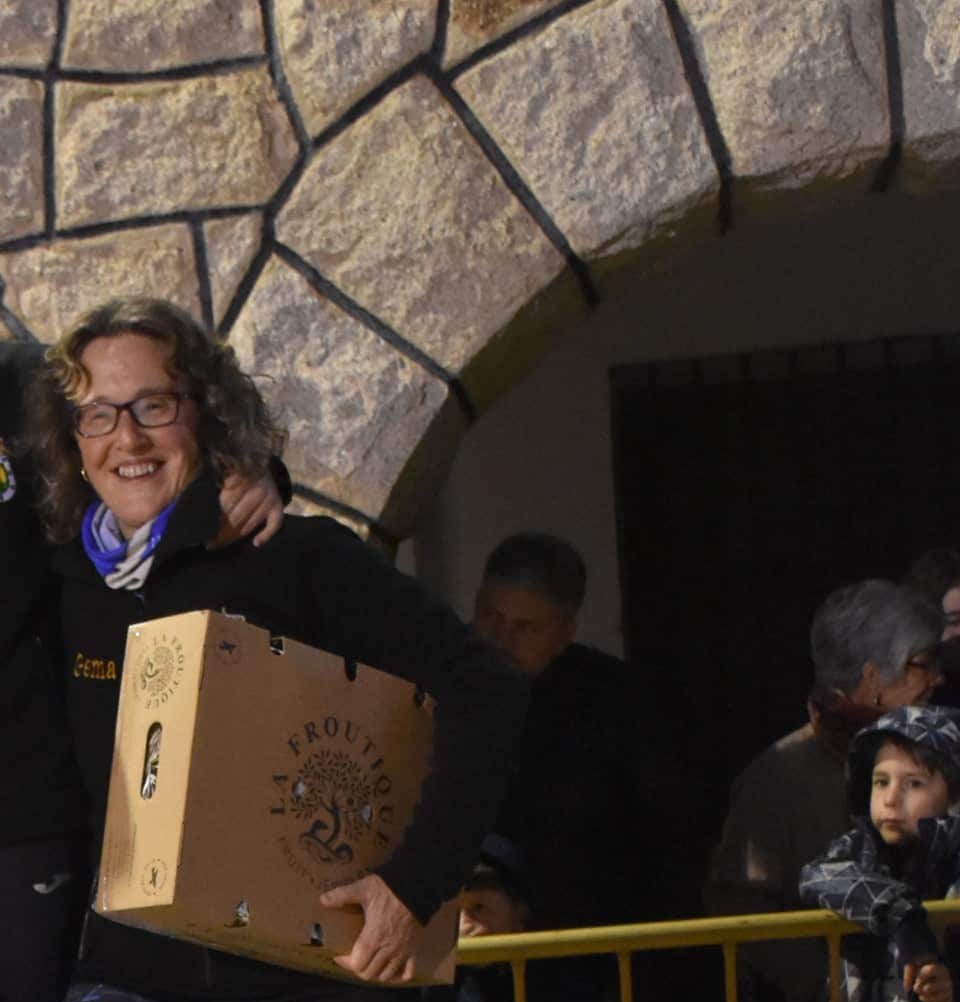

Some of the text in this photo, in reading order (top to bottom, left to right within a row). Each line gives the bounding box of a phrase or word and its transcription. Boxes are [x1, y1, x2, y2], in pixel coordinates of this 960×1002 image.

[73, 652, 117, 680] Gema
[270, 716, 393, 847] LA FROUTIQUE
